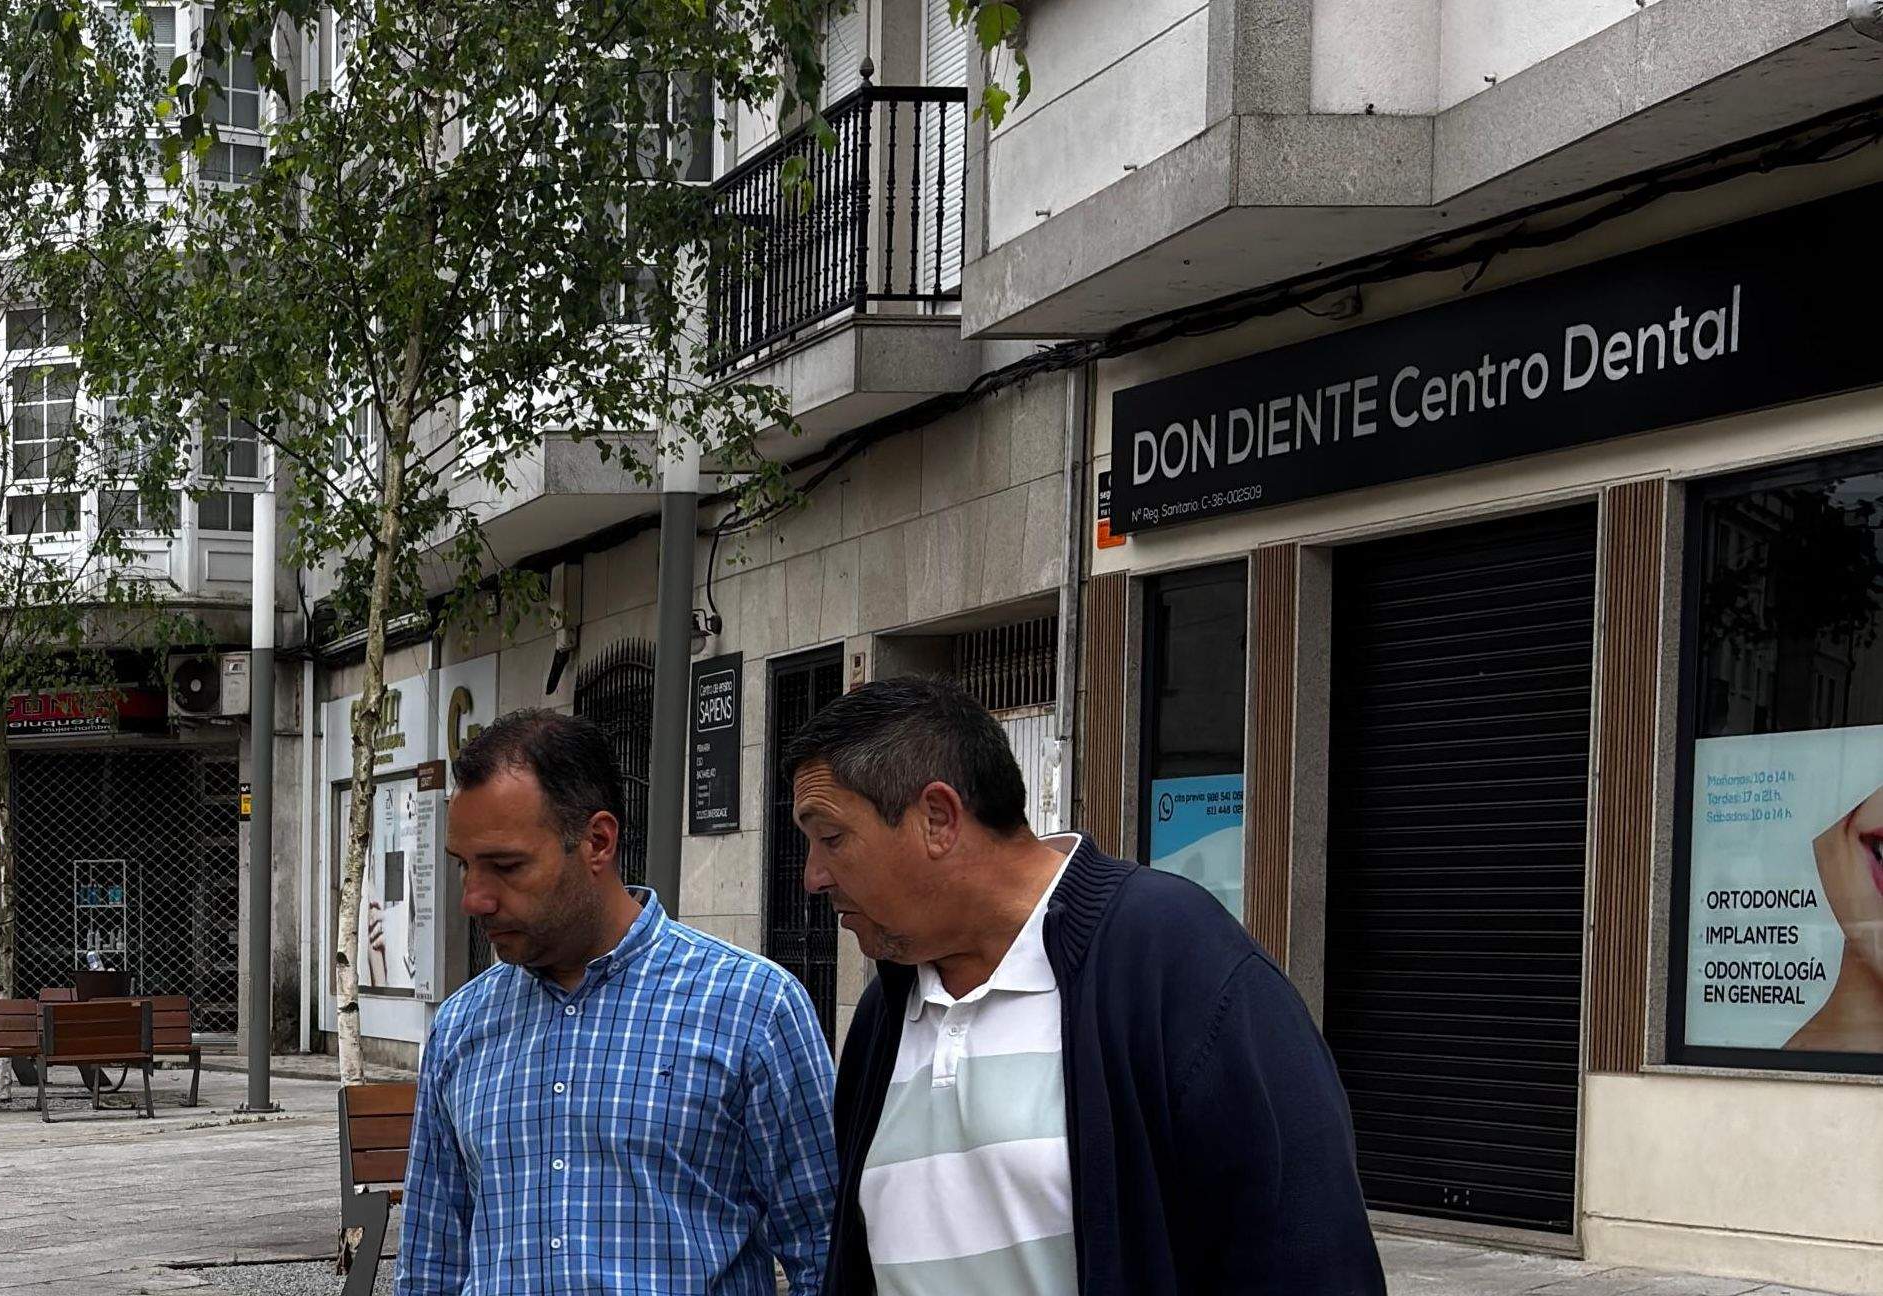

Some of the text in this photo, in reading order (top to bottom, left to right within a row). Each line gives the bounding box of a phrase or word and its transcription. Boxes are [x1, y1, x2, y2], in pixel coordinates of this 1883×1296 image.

[1132, 284, 1742, 486] DON DIENTE Centro Dental
[699, 695, 733, 724] SAPIENS
[1706, 889, 1818, 910] ORTODONCIA
[1705, 925, 1799, 945] IMPLANTES
[1704, 957, 1827, 981] ODONTOLOGÍA
[1703, 984, 1806, 1005] EN GENERAL
